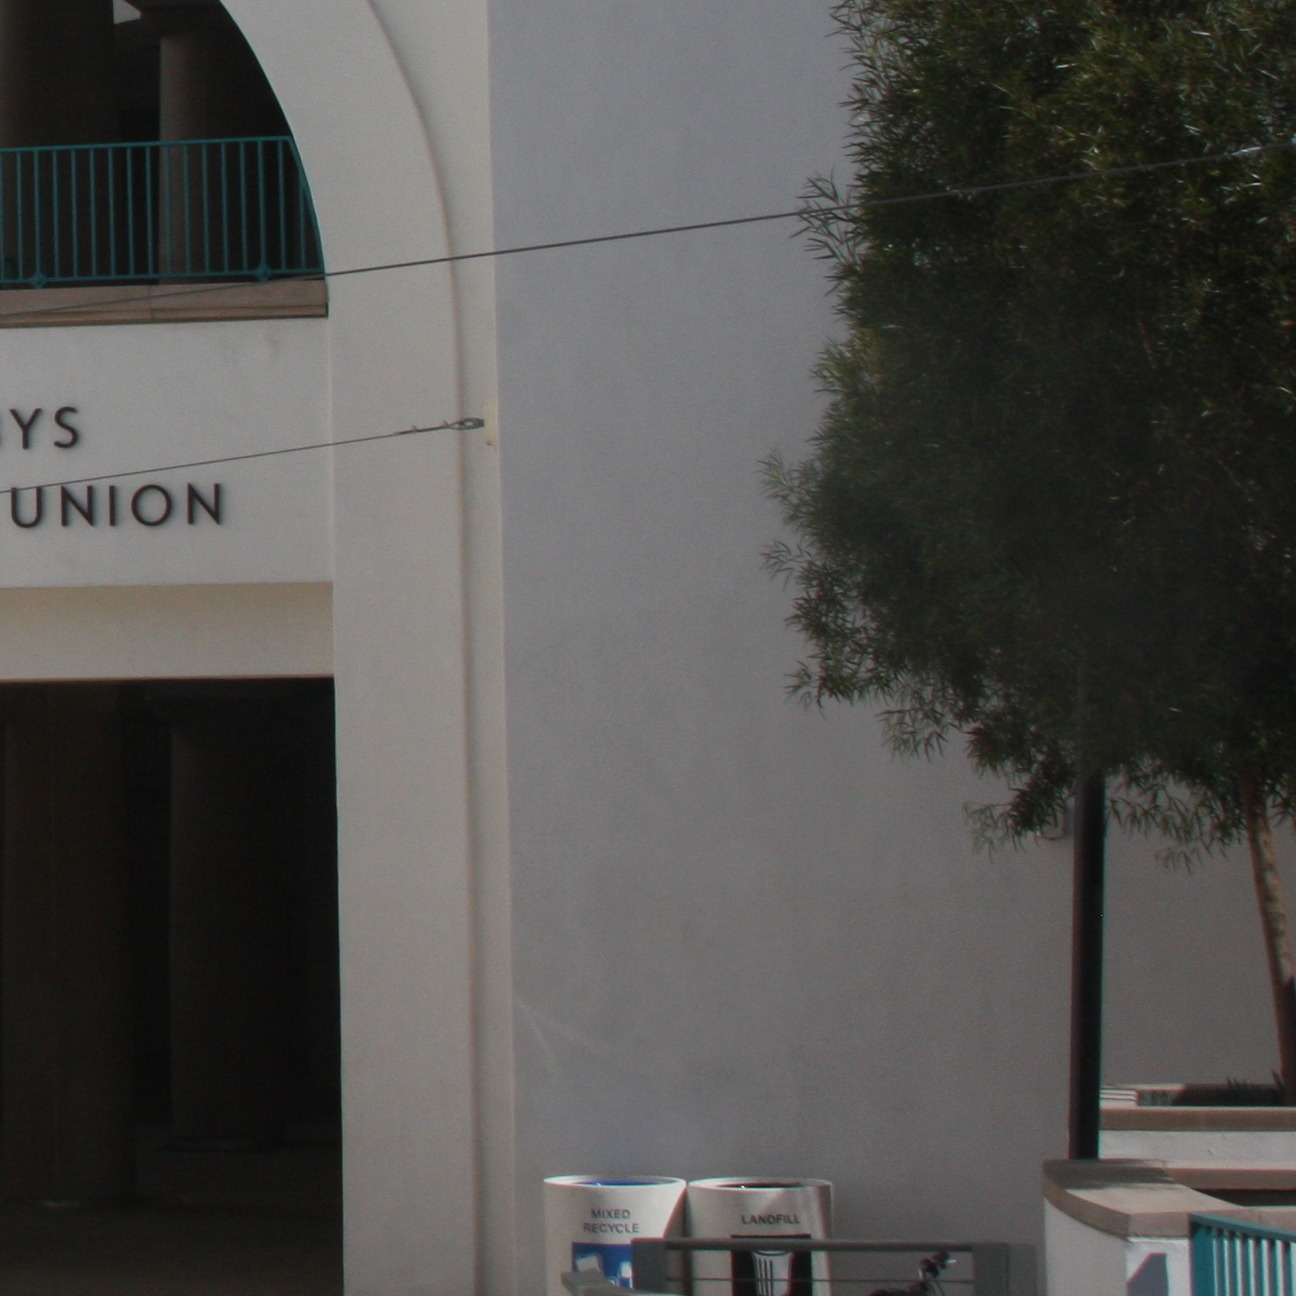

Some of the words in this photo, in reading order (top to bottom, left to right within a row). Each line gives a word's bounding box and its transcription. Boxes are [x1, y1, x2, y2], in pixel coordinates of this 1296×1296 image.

[10, 483, 222, 529] UNION
[591, 1208, 631, 1219] MIXED
[740, 1213, 801, 1225] LANDFILL
[583, 1223, 640, 1234] RECYCLE
